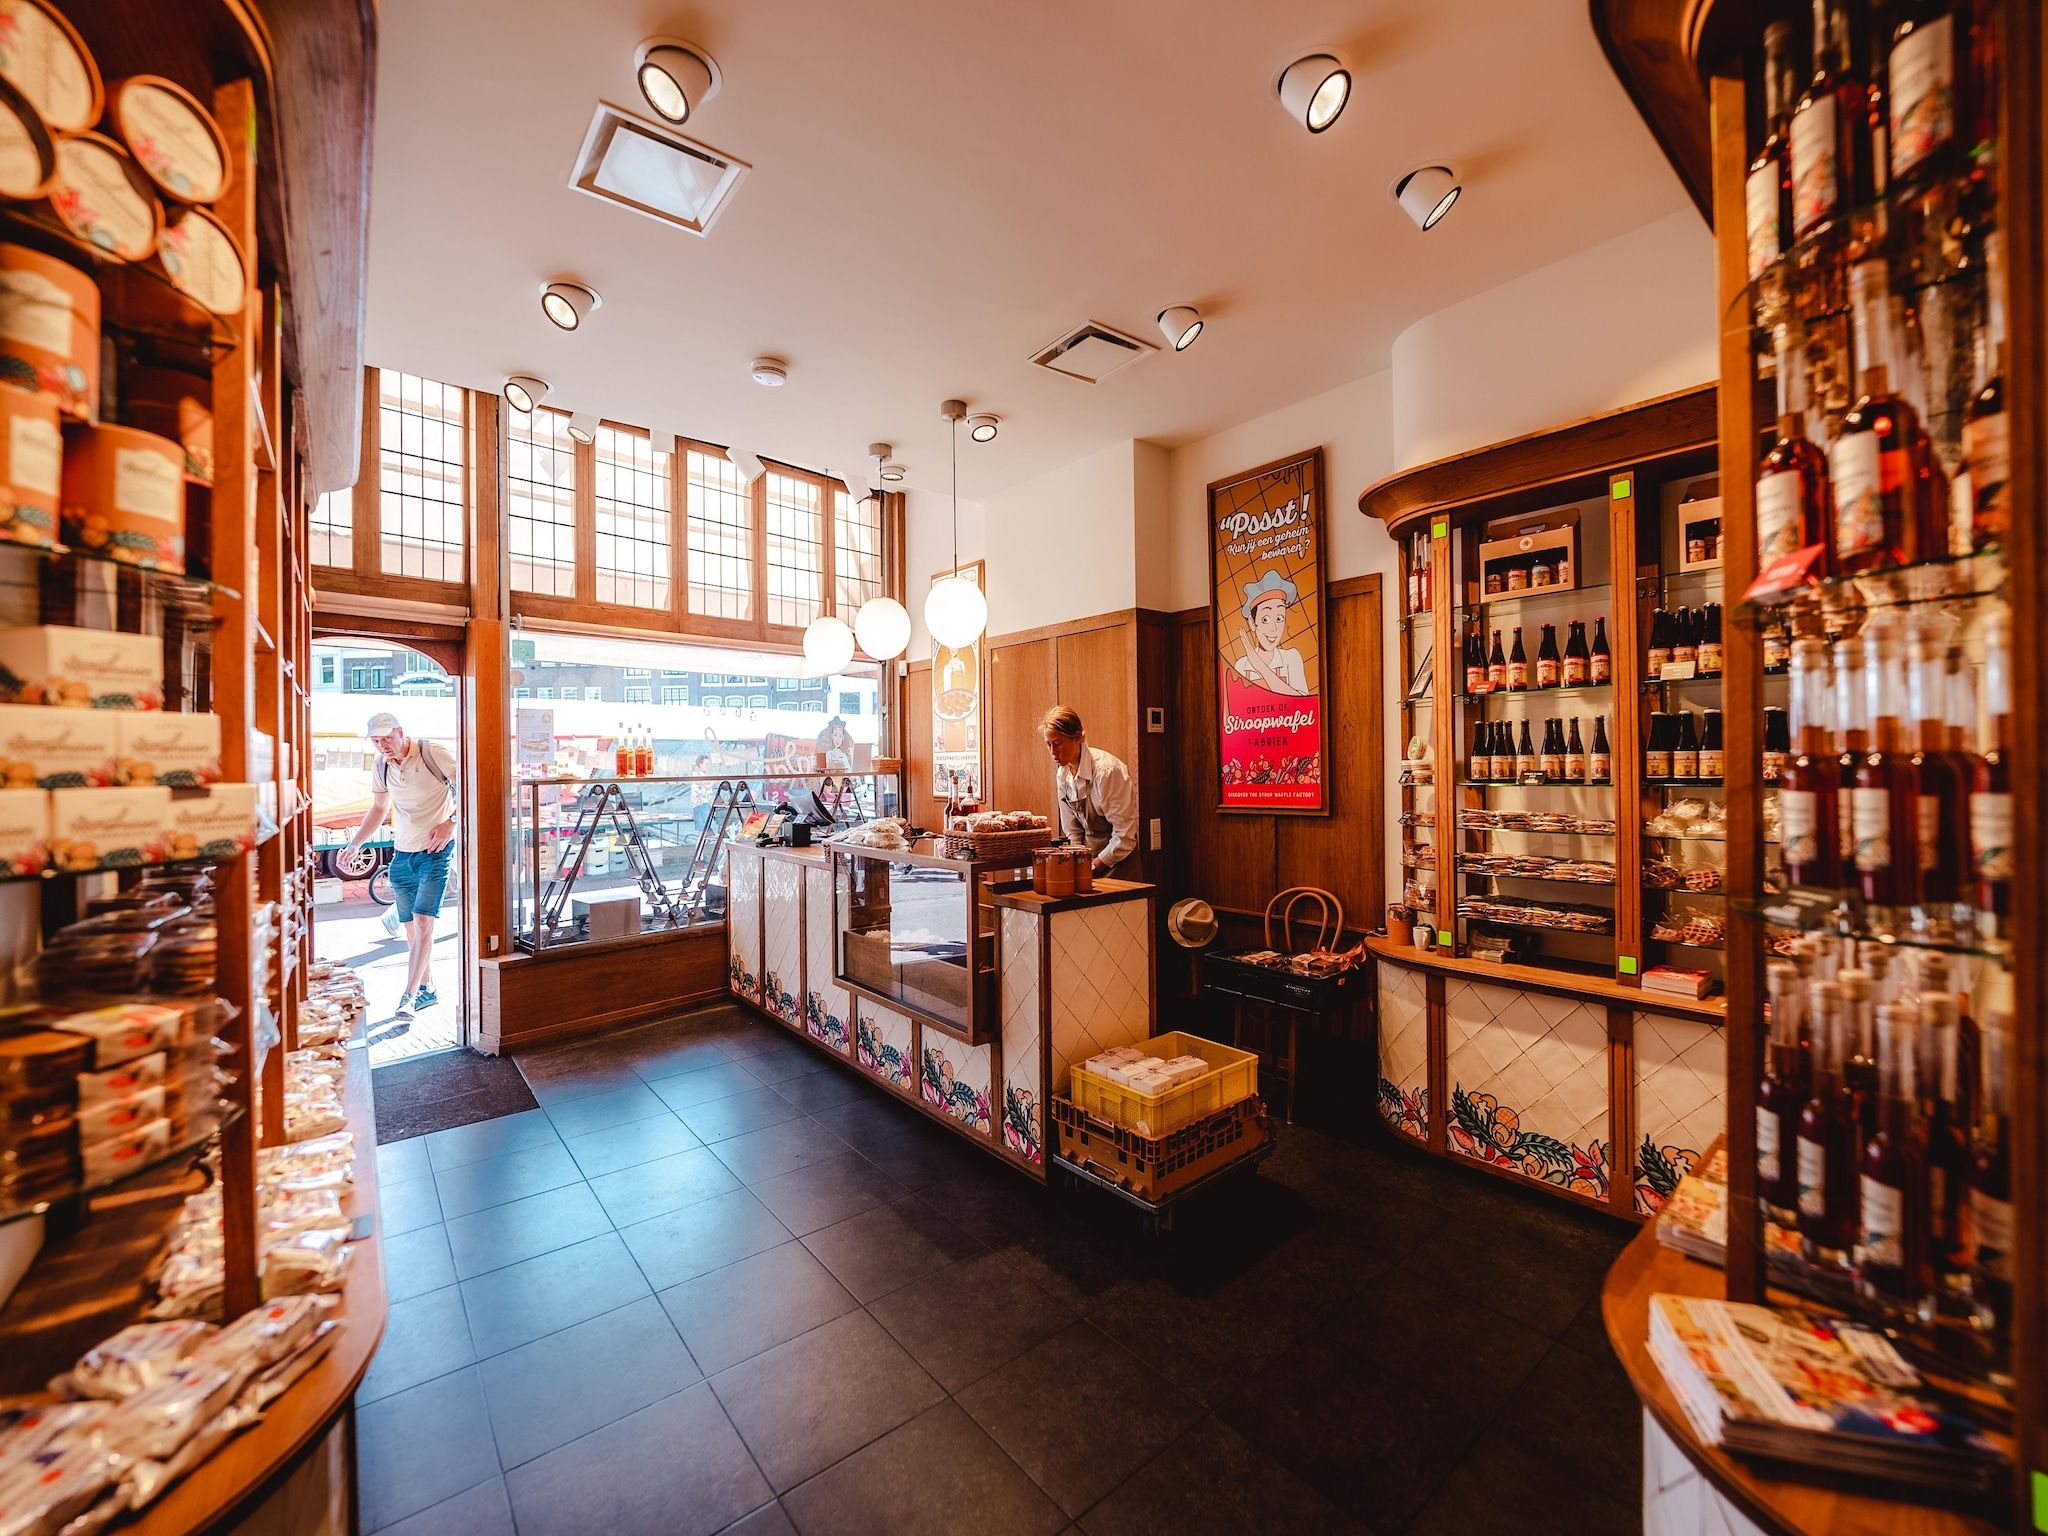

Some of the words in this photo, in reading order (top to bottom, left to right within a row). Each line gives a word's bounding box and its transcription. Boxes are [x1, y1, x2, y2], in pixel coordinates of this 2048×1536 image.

[1227, 543, 1246, 556] Kun
[1245, 538, 1256, 554] jij
[1257, 536, 1273, 547] een
[1274, 526, 1309, 546] geheim
[1246, 704, 1275, 714] ONTDEK
[1278, 703, 1289, 712] DE
[1224, 709, 1315, 735] Siroopwafel
[1248, 736, 1288, 748] FABRIEK
